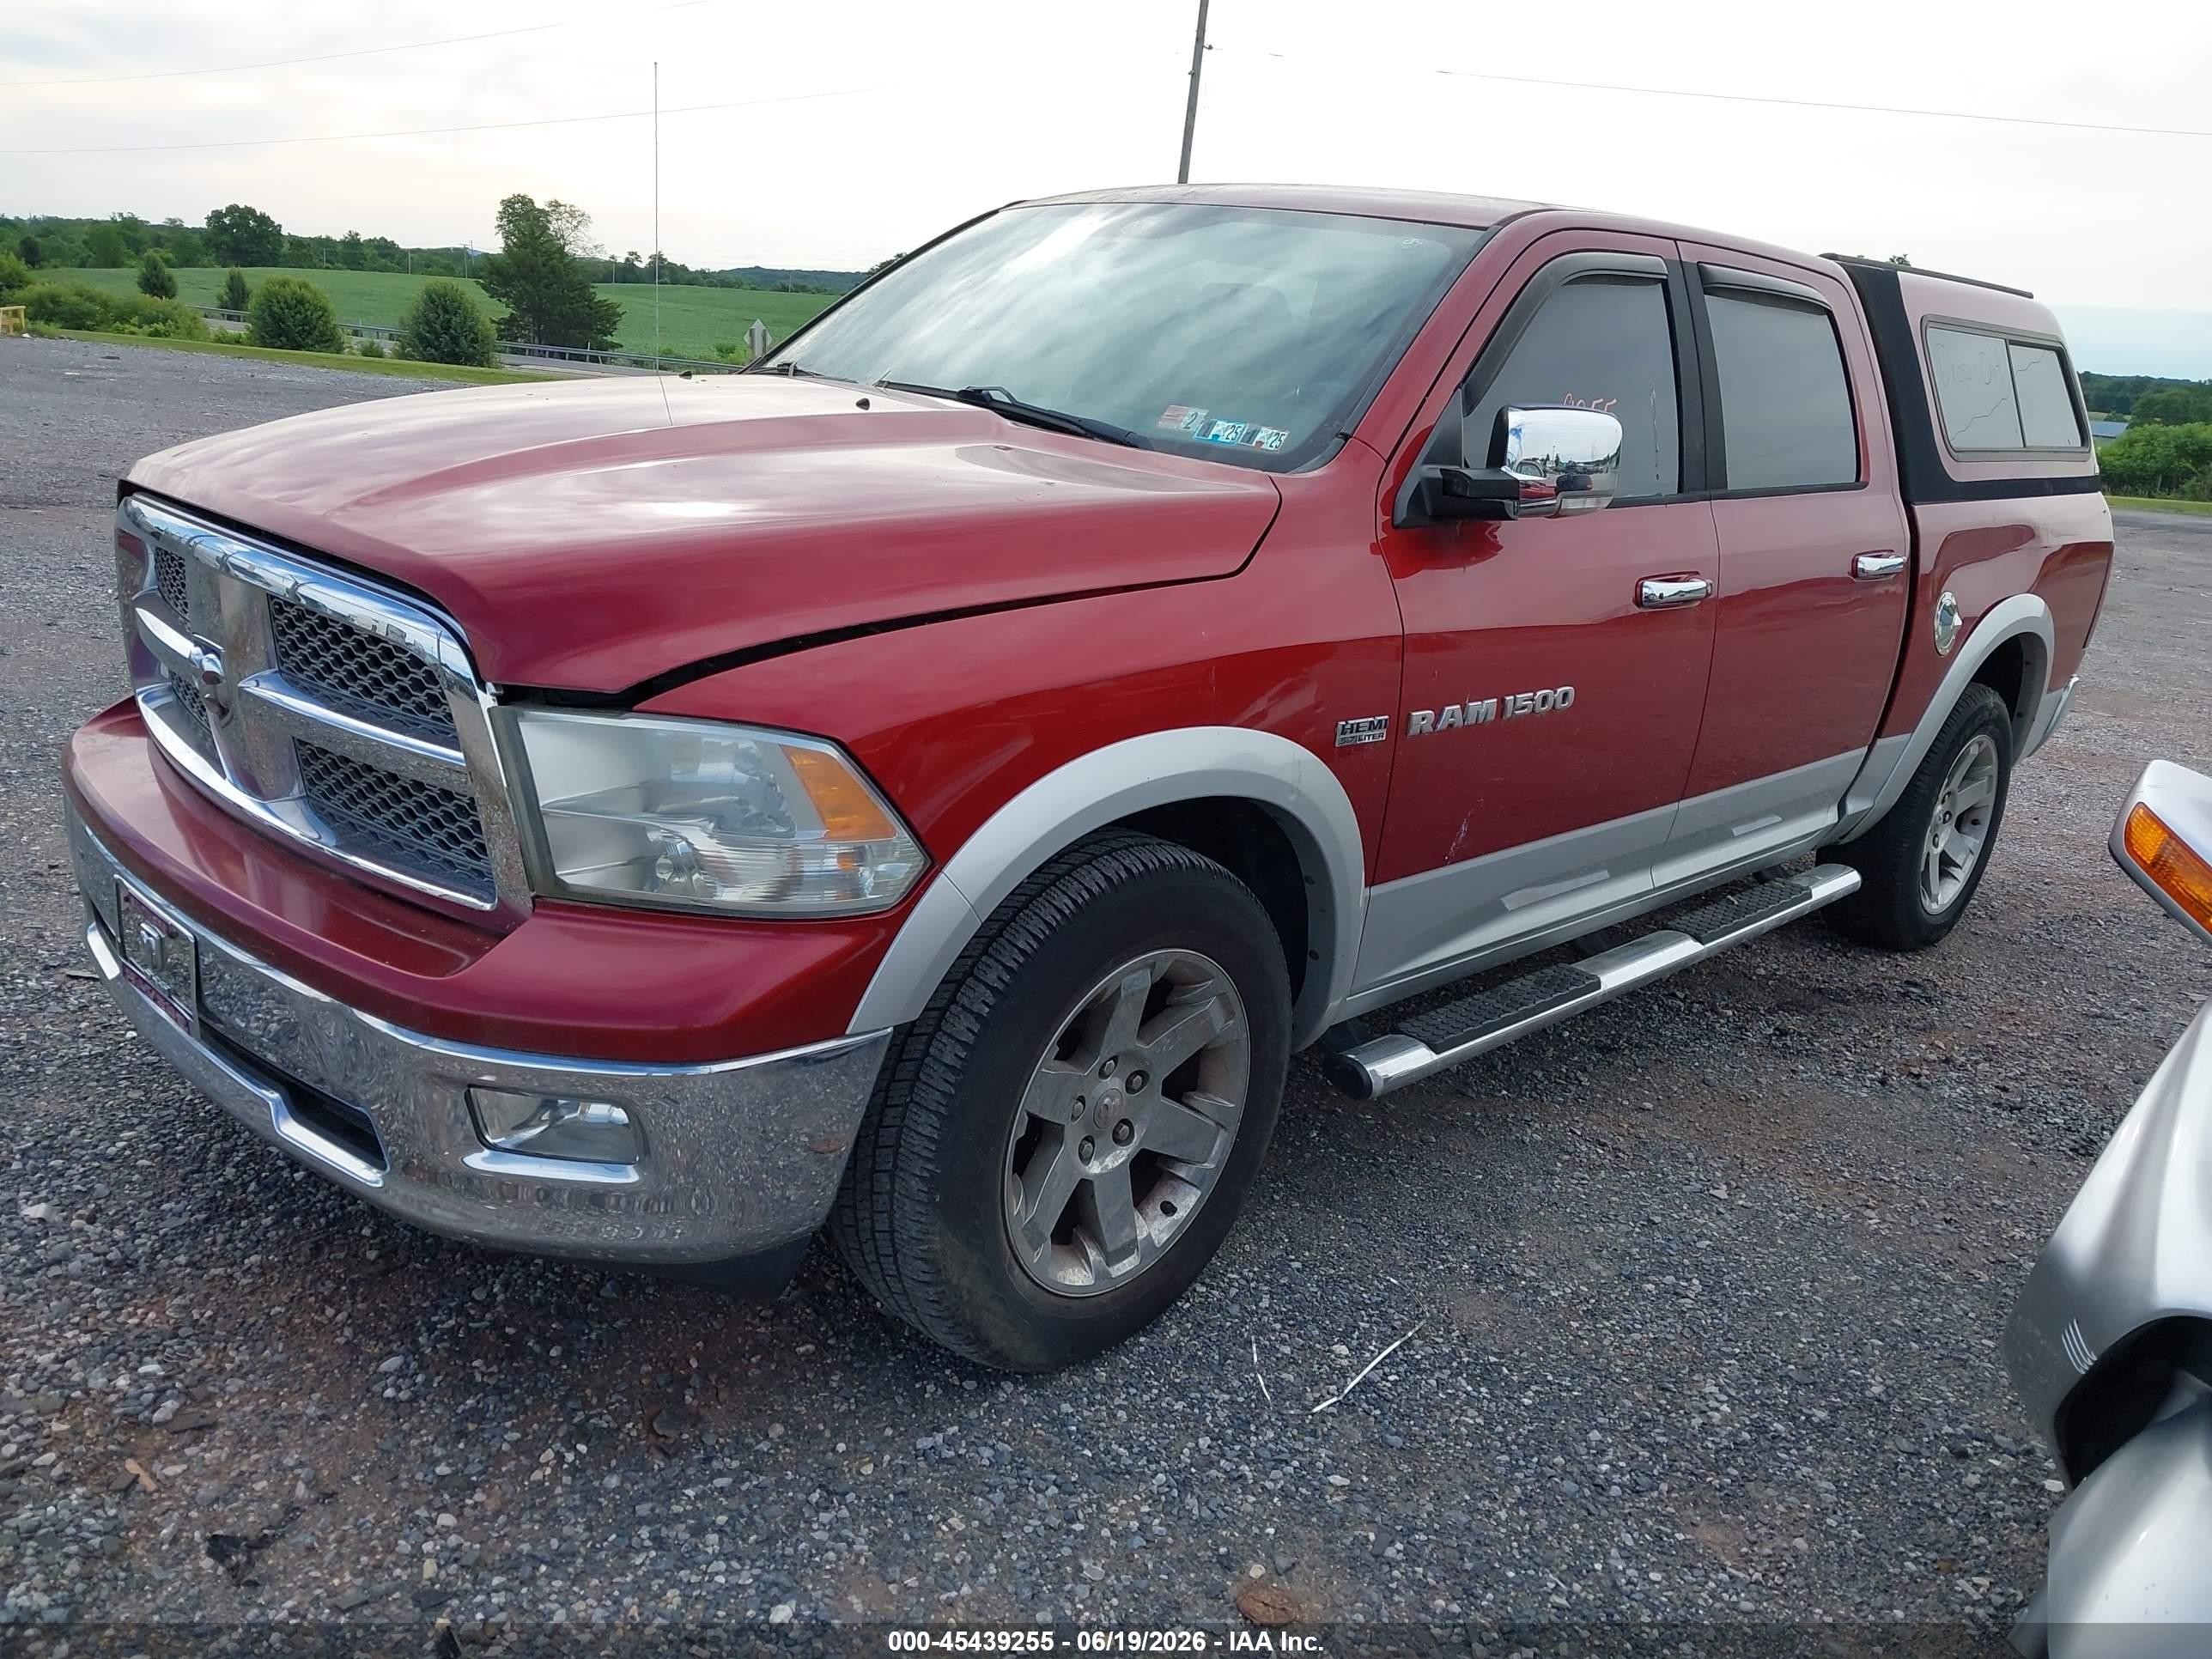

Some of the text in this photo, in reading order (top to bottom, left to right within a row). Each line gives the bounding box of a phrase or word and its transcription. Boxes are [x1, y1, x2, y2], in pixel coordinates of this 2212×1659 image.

[1183, 412, 1198, 429] 2
[1225, 425, 1243, 441] 25
[1268, 432, 1285, 449] 25
[1407, 685, 1576, 737] RAM 1500
[1339, 717, 1389, 736] HEMI
[1357, 732, 1385, 742] LITER
